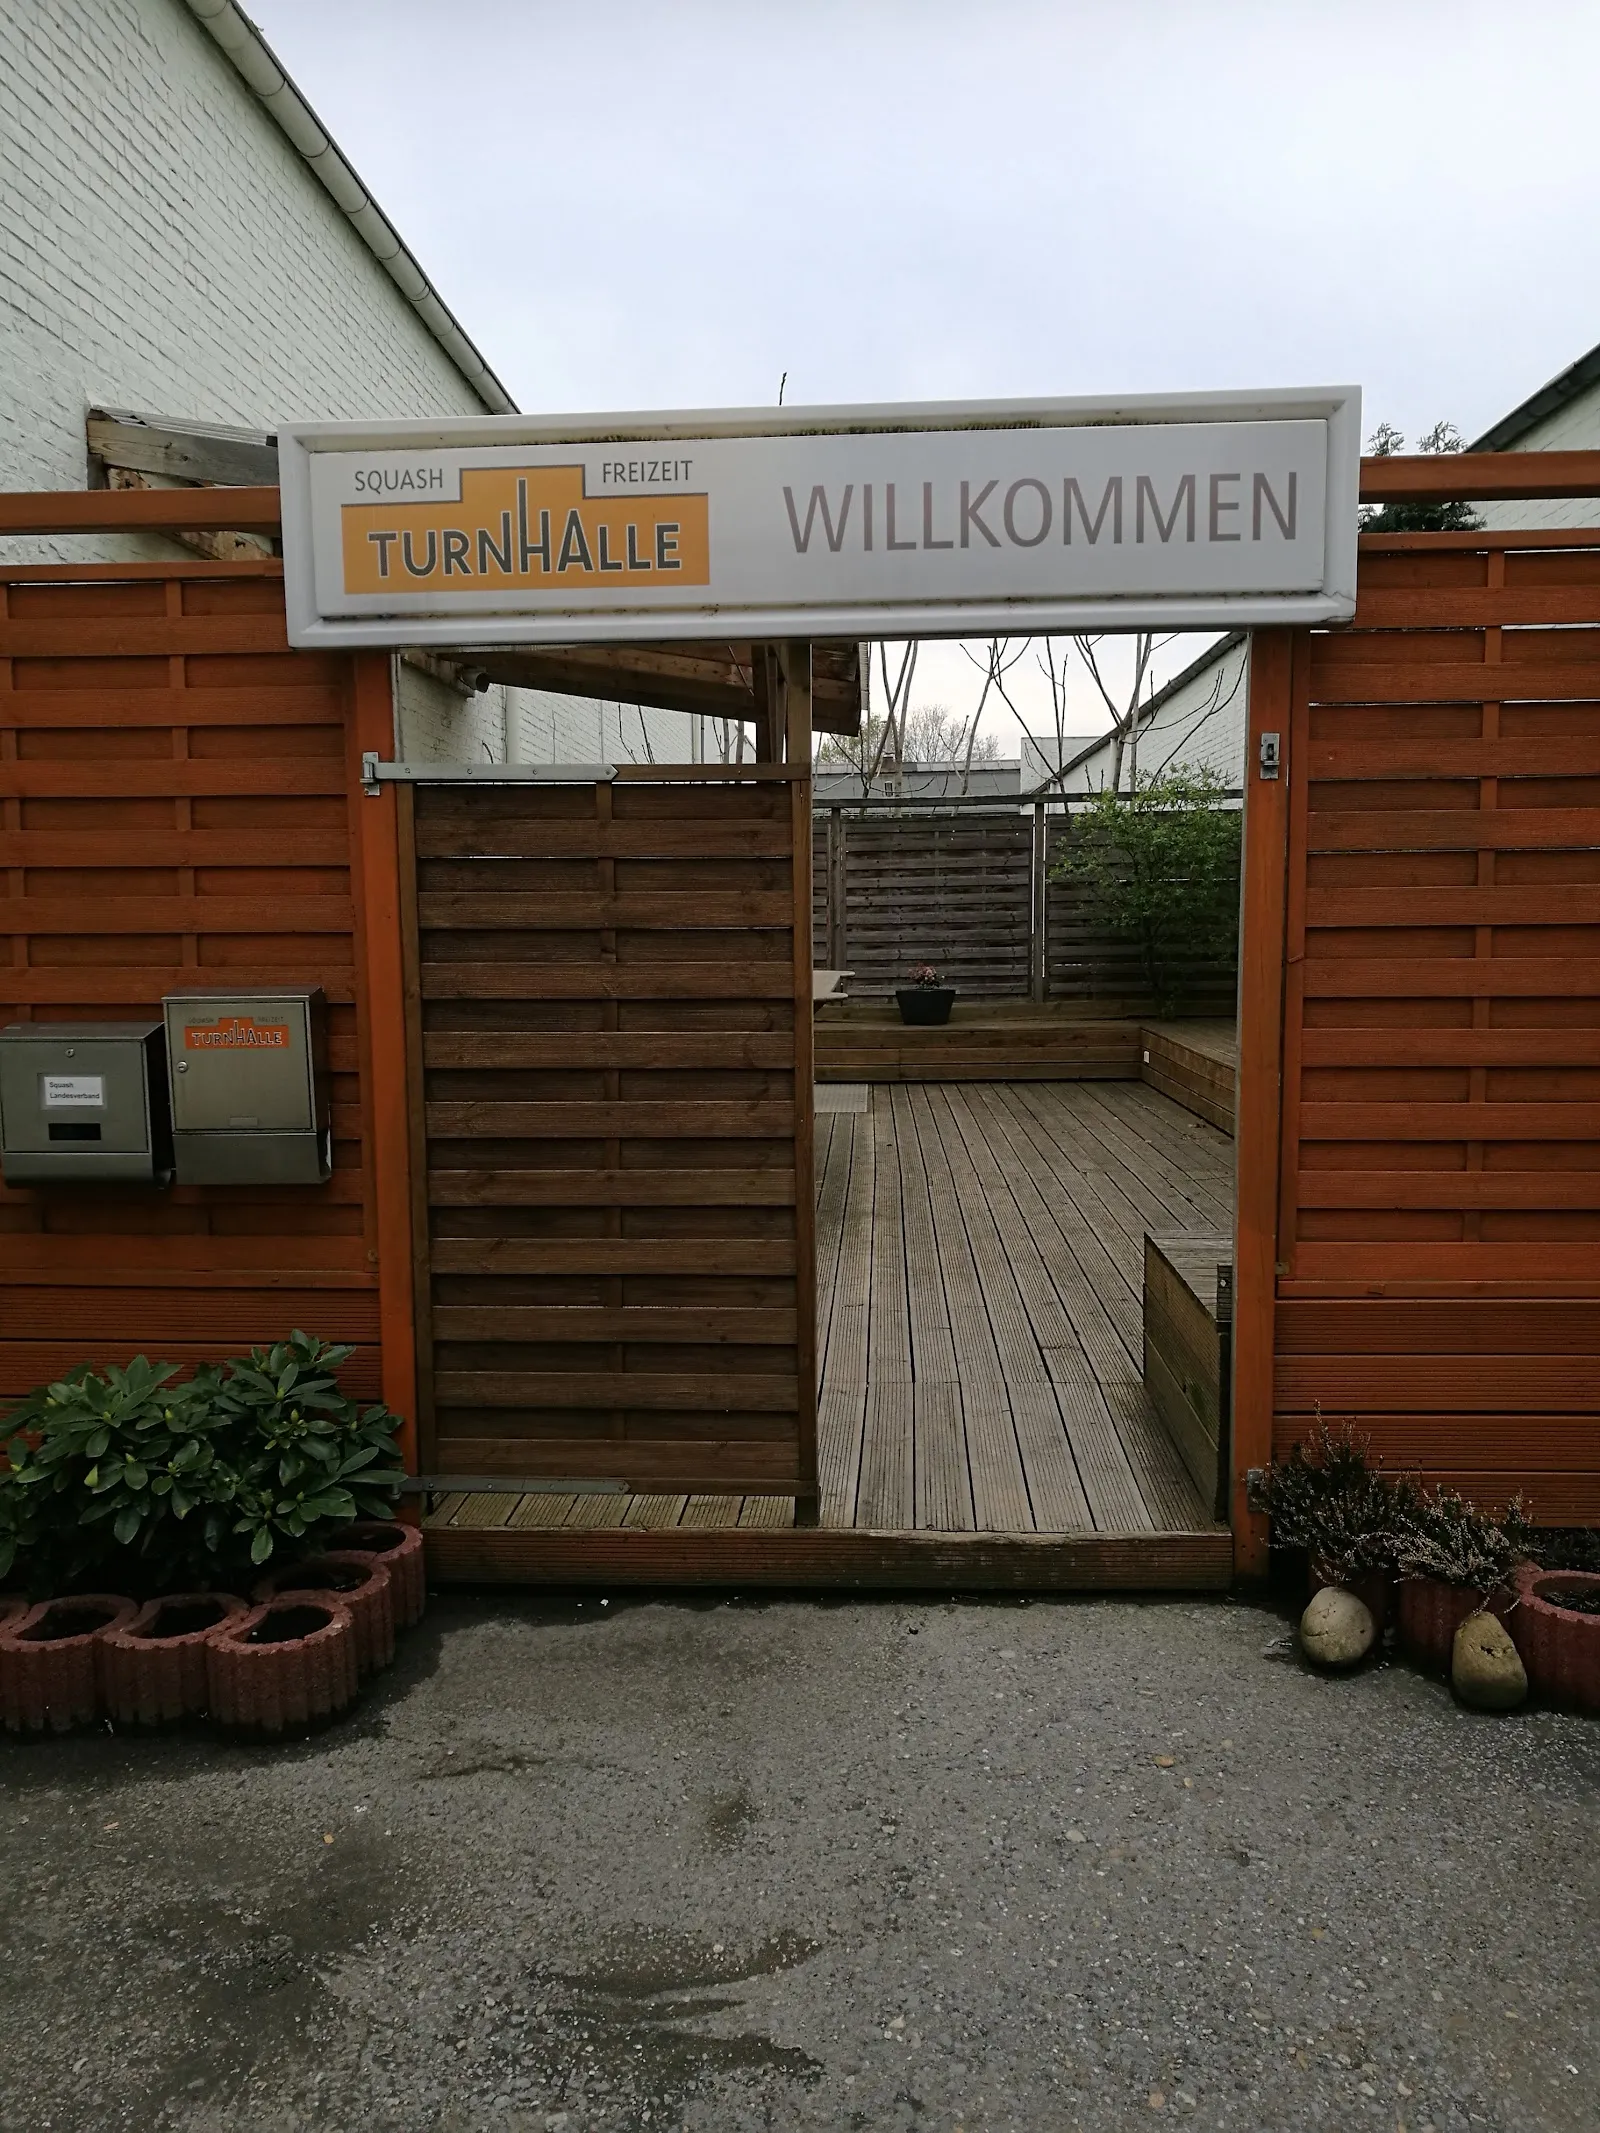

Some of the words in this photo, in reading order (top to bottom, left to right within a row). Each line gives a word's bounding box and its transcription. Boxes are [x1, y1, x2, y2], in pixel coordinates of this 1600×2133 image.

[355, 468, 443, 494] SQUASH
[602, 460, 694, 483] FREIZEIT
[783, 471, 1297, 553] WILLKOMMEN
[368, 478, 683, 577] TURNHALLE
[192, 1020, 283, 1046] TURNHALLE
